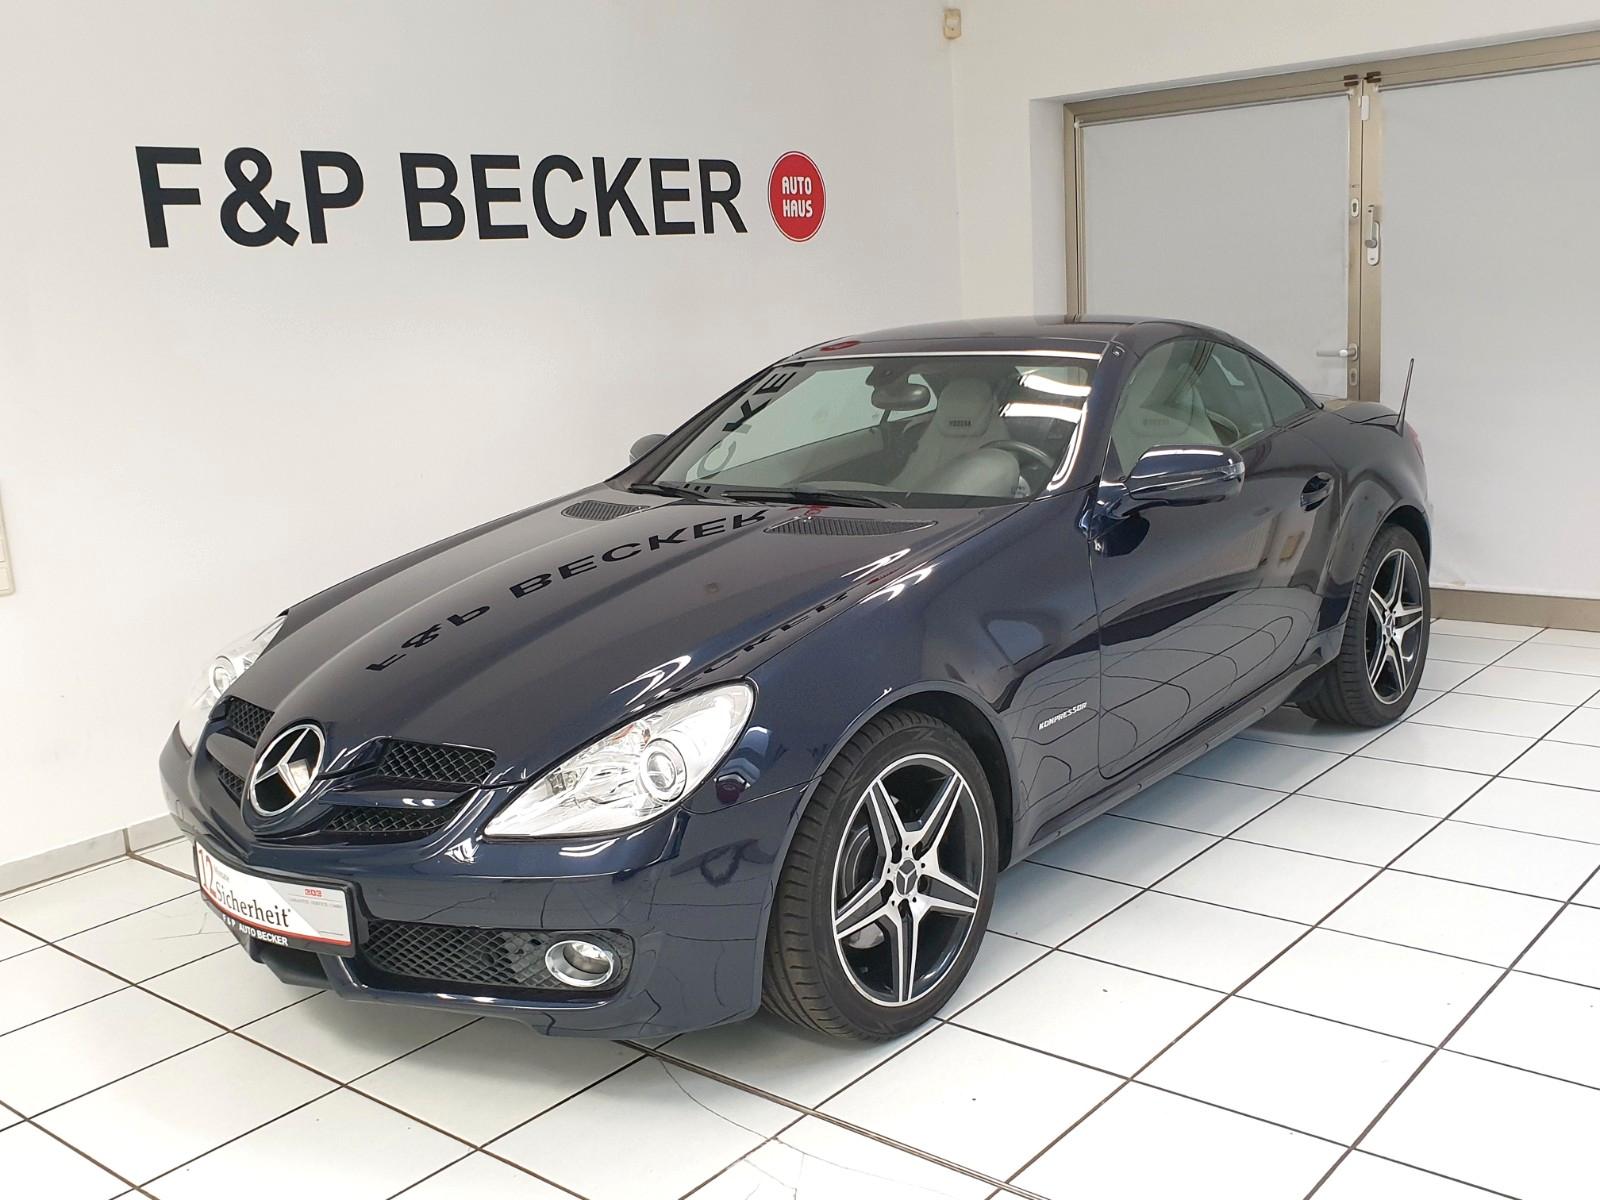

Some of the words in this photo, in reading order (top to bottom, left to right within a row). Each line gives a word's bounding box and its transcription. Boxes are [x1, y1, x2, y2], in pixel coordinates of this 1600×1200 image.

[135, 146, 364, 248] F&P
[400, 152, 748, 242] BECKER
[782, 176, 812, 195] AUTO
[782, 199, 813, 218] HAUS
[1038, 702, 1087, 731] KOMPRESSOR
[215, 881, 289, 928] Sicherheit
[239, 922, 256, 937] AUTO
[256, 929, 289, 947] BECKER
